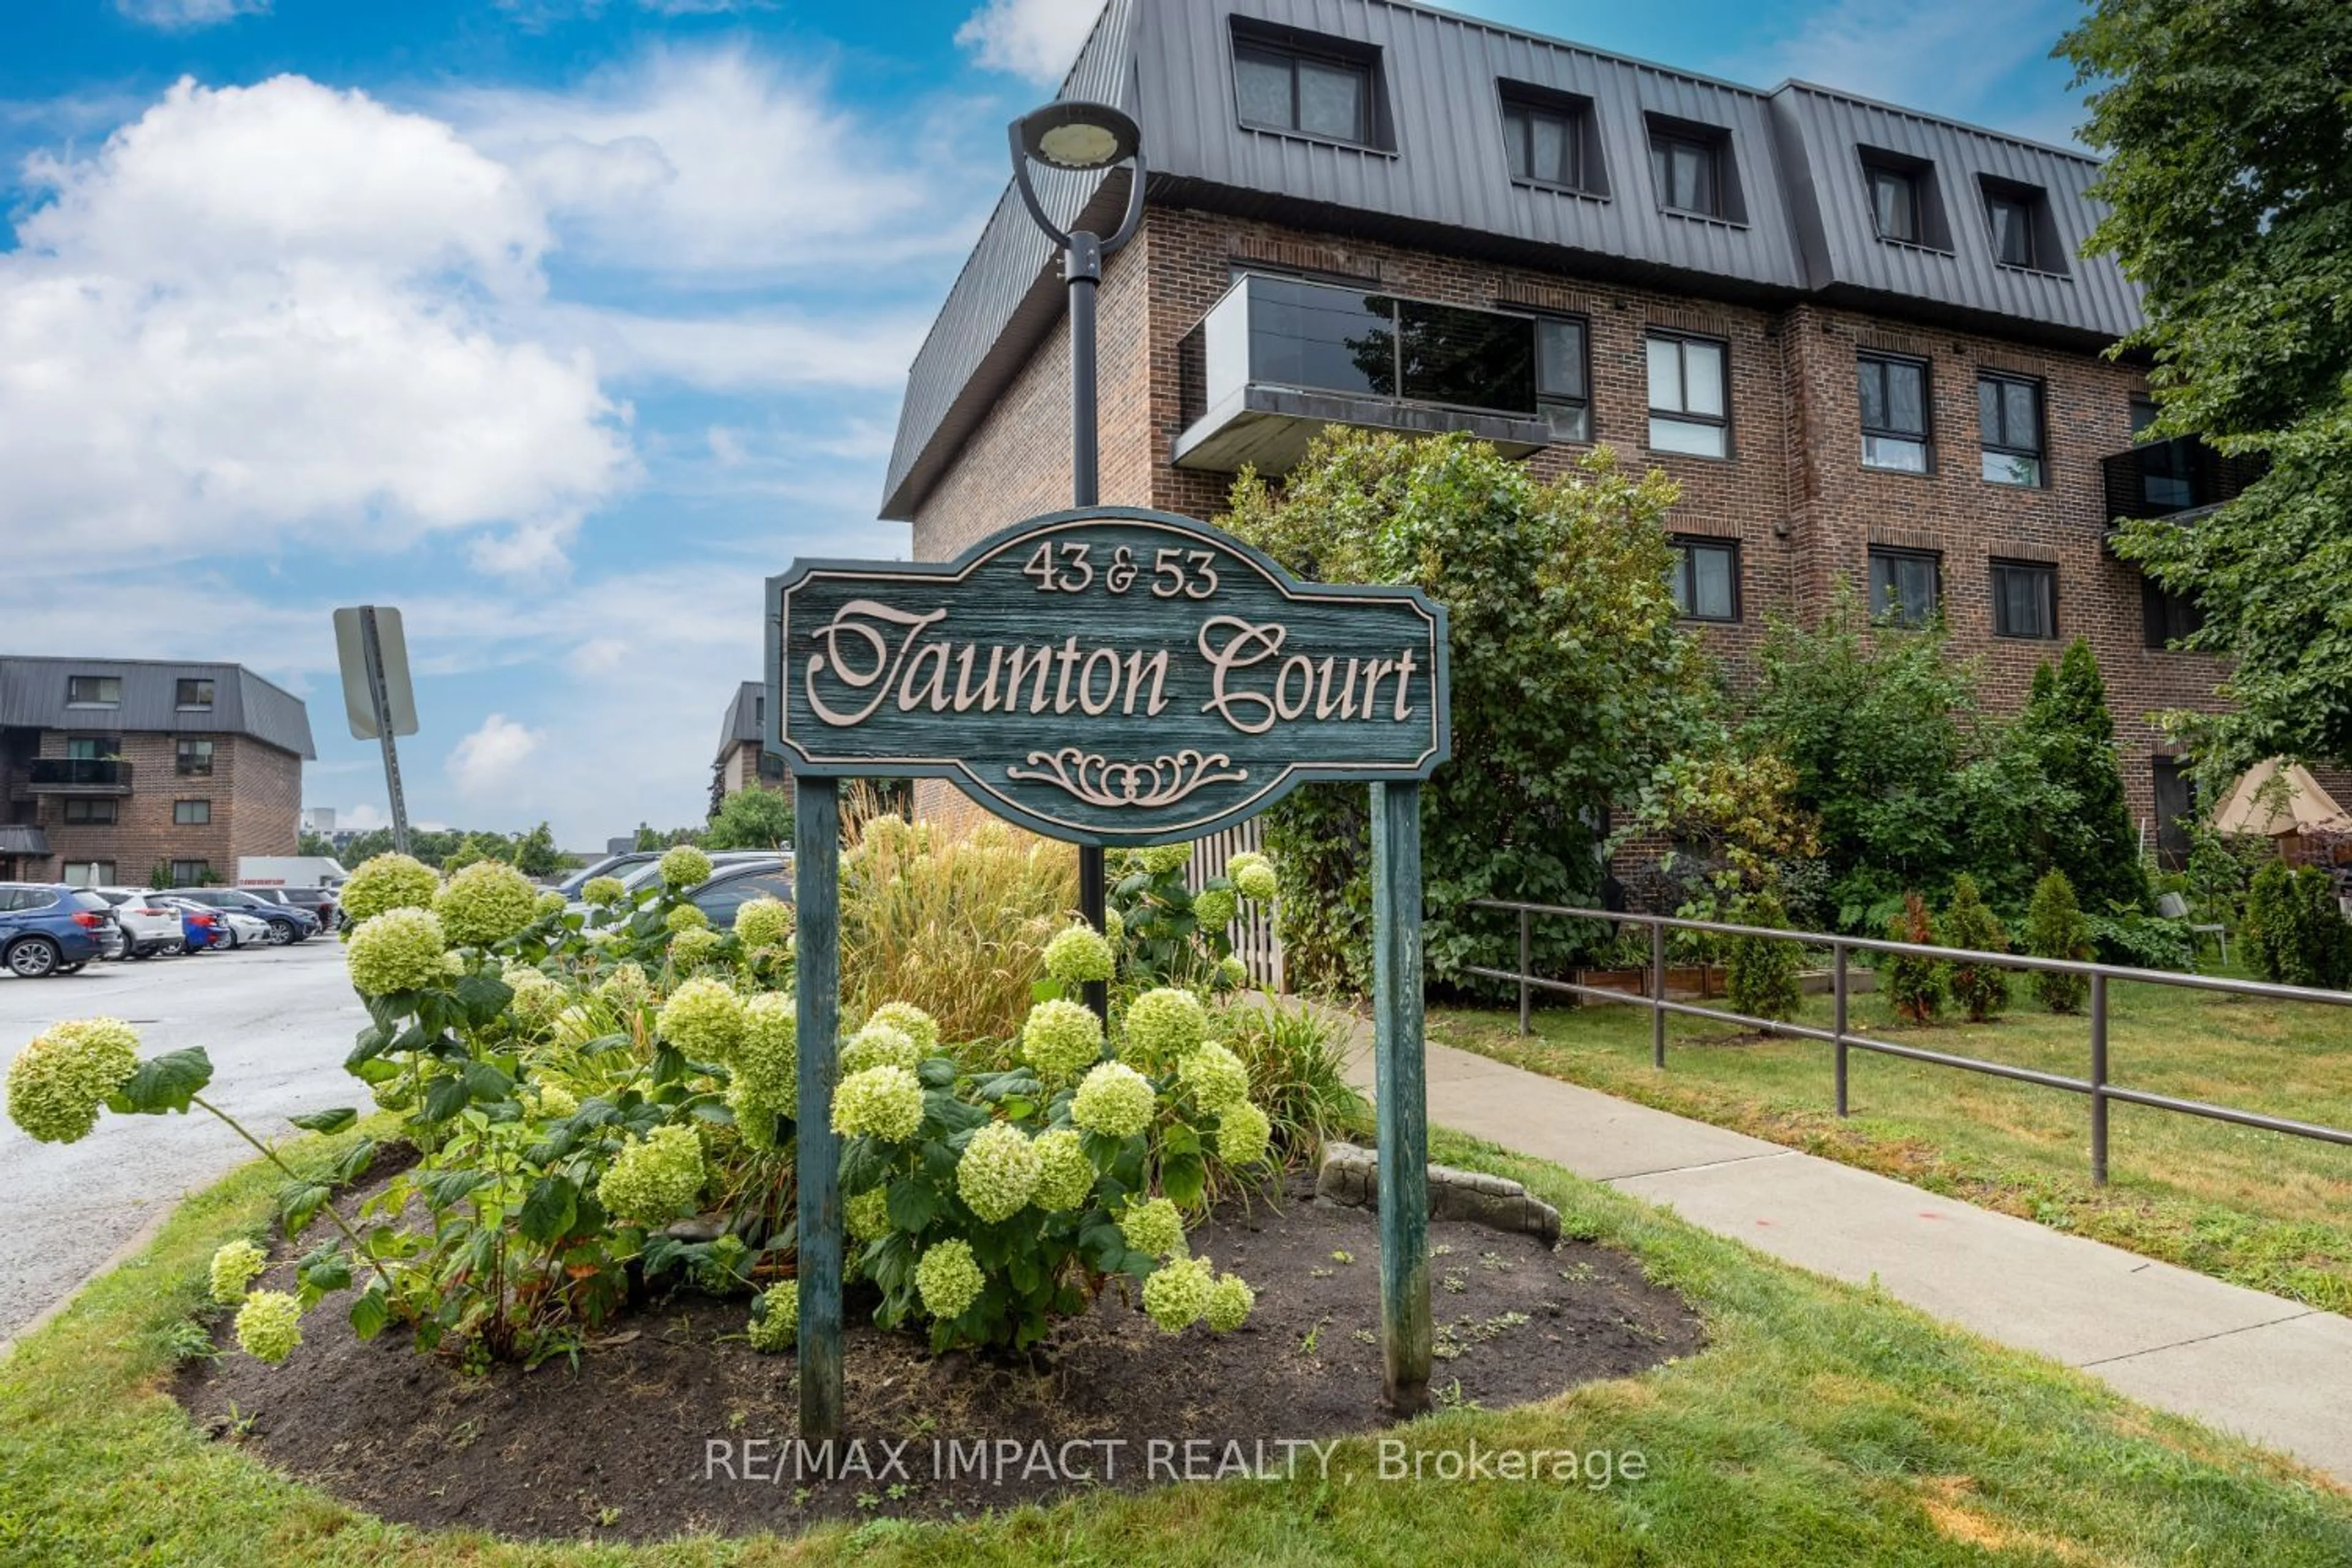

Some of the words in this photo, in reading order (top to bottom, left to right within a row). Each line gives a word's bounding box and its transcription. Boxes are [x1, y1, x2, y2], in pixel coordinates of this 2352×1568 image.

[1023, 541, 1094, 593] 43
[1106, 545, 1139, 594] &
[1152, 549, 1219, 599] 53
[805, 600, 1170, 726] Taunton
[1199, 615, 1417, 734] Court
